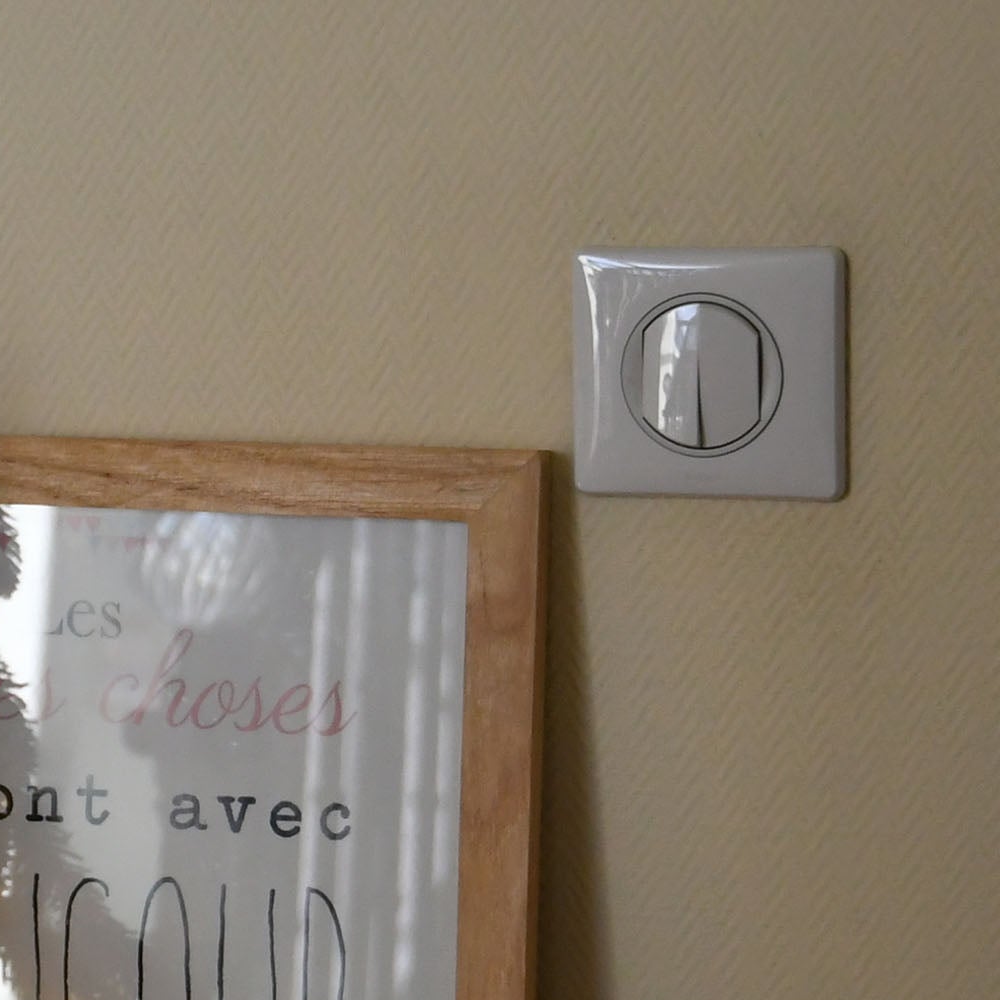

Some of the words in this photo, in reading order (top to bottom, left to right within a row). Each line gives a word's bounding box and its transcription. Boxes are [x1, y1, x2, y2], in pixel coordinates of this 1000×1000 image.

[45, 599, 123, 640] es
[100, 628, 357, 737] choses
[168, 791, 352, 841] avec
